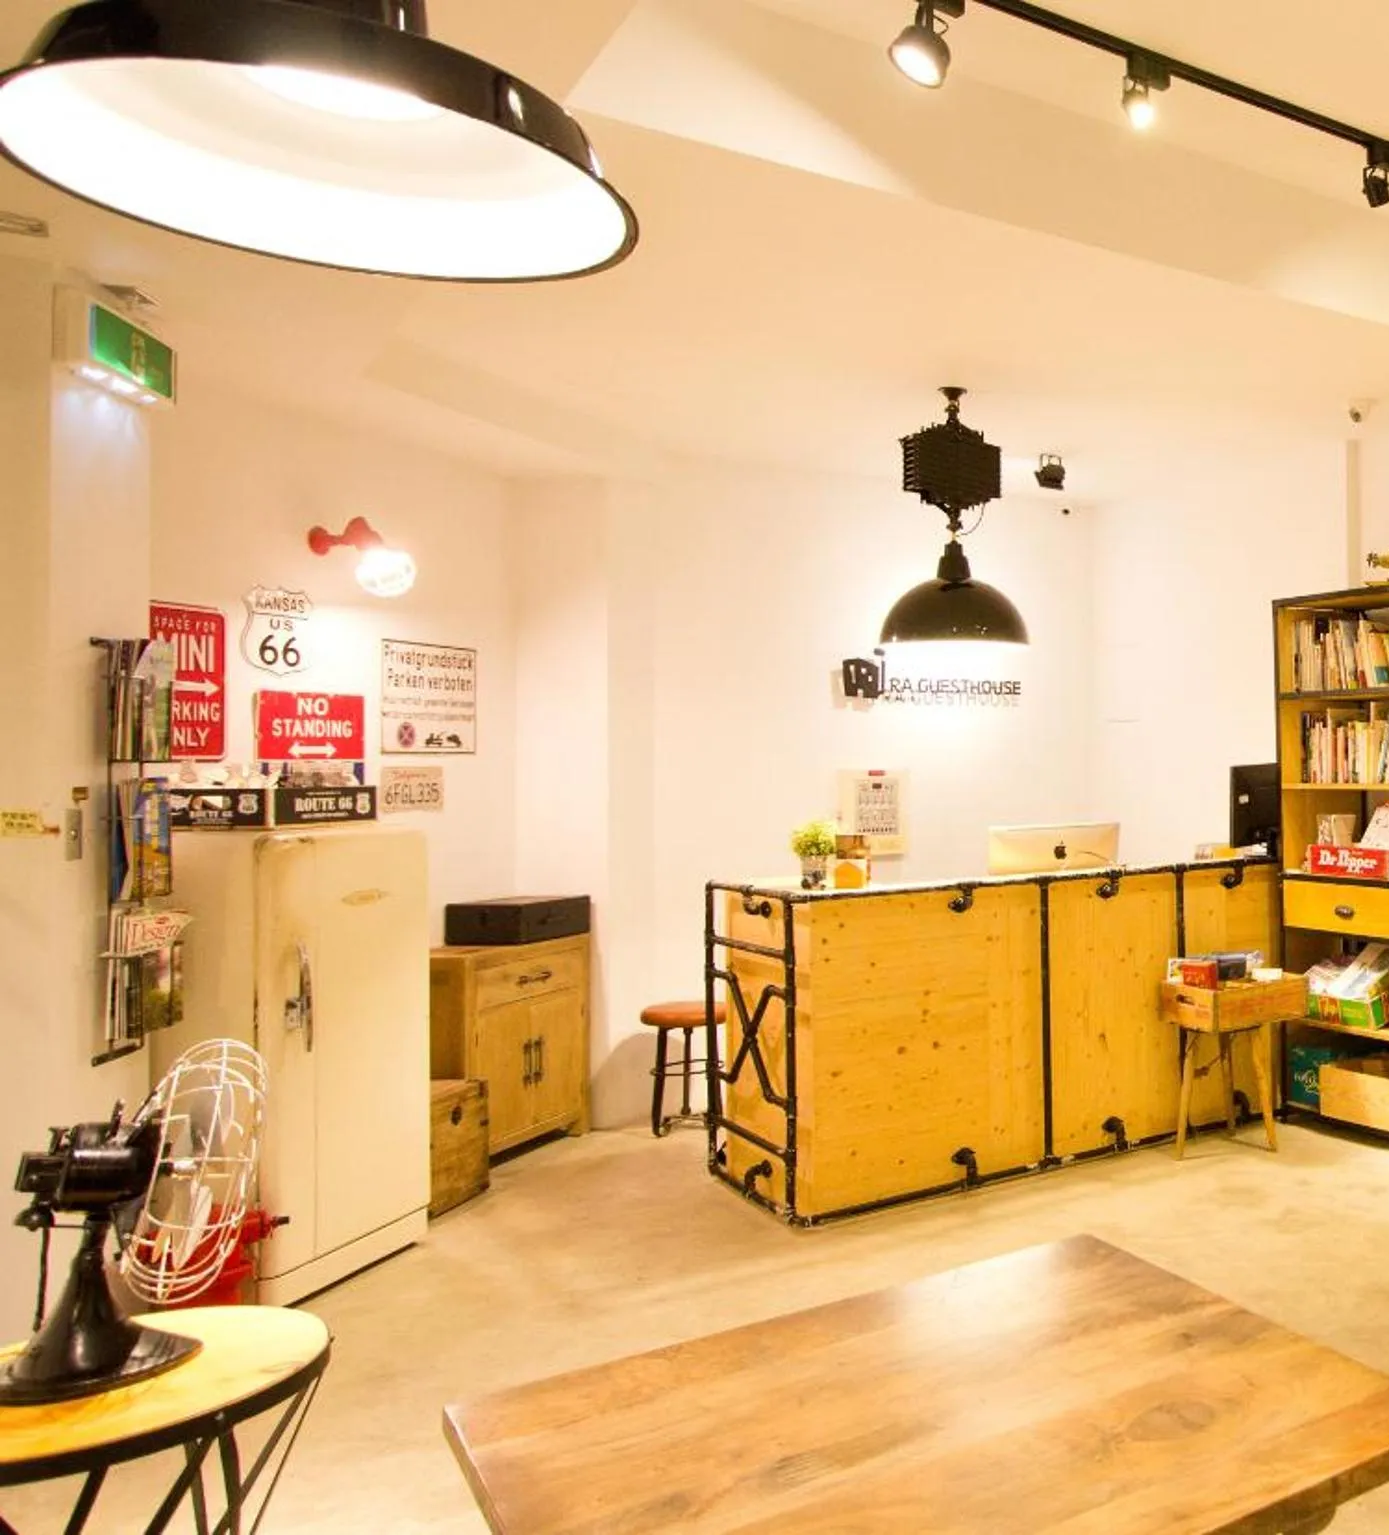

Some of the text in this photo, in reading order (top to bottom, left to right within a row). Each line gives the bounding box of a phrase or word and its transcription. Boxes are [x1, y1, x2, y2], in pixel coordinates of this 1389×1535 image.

[255, 595, 306, 614] KANSAS
[259, 634, 301, 668] 66
[889, 678, 1022, 696] RA GUESTHOUSE
[171, 701, 221, 722] RKING
[297, 698, 330, 716] NO
[172, 726, 211, 748] NLY
[271, 718, 353, 738] STANDING
[295, 797, 354, 813] ROUTE 66
[1318, 848, 1338, 866] Dr
